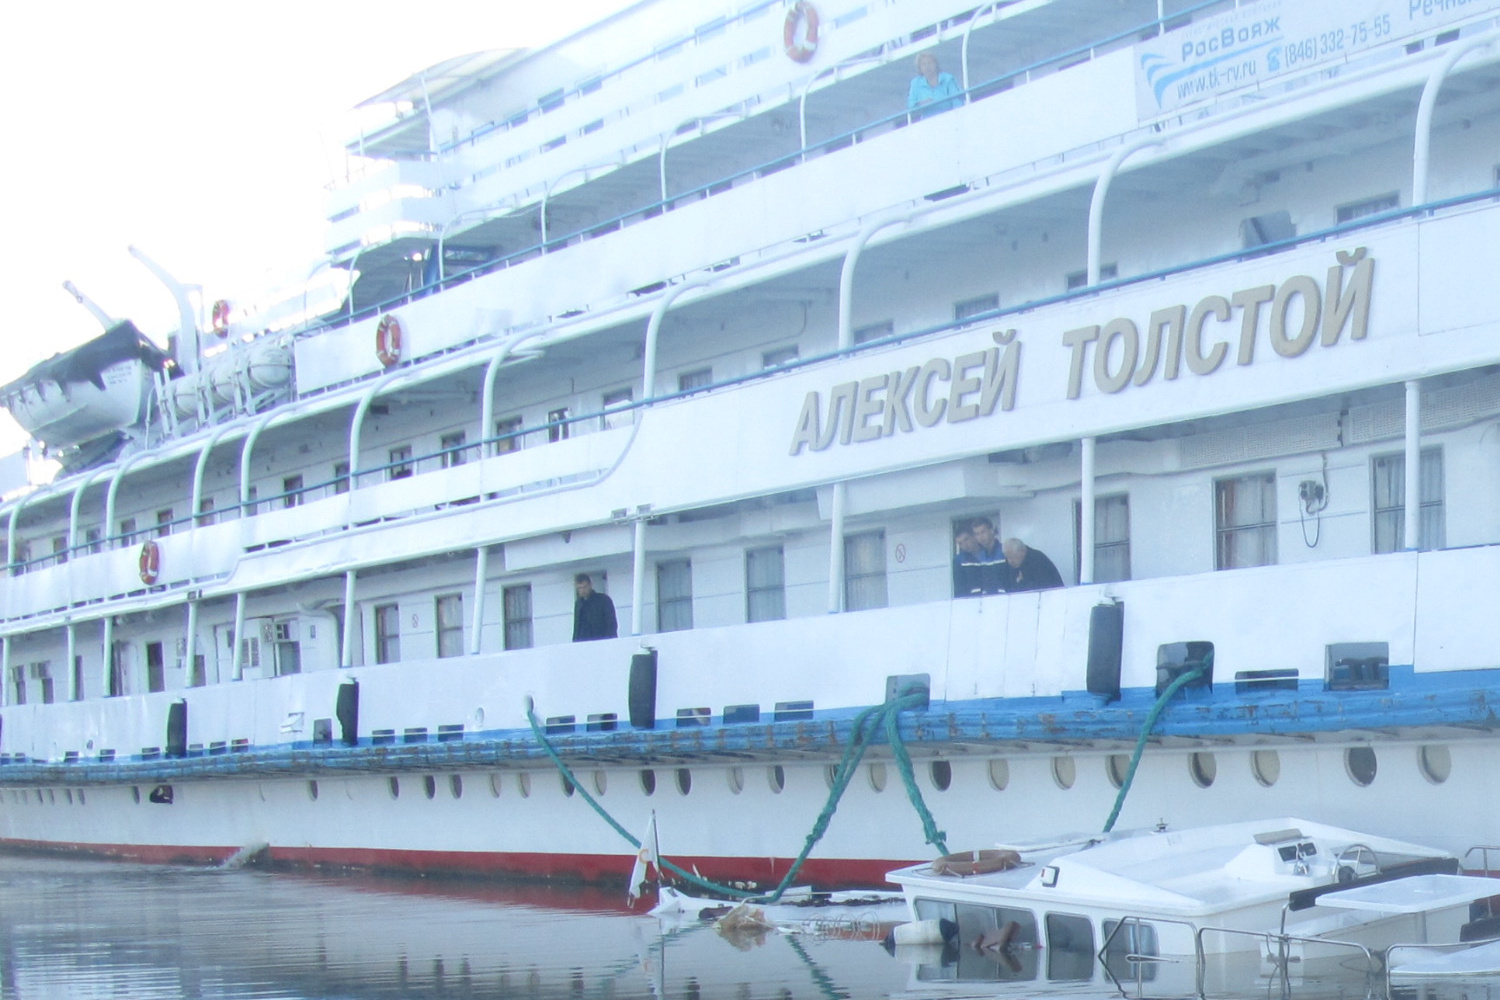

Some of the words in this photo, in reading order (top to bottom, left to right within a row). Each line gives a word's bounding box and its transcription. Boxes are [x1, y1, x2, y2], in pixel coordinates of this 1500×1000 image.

[1182, 16, 1280, 62] РосВояж
[1284, 37, 1318, 68] (846)
[1319, 14, 1391, 54] 332-75-55
[788, 328, 1022, 456] АЛЕКСЕЙ
[1061, 246, 1375, 400] ТОЛСТОЙ
